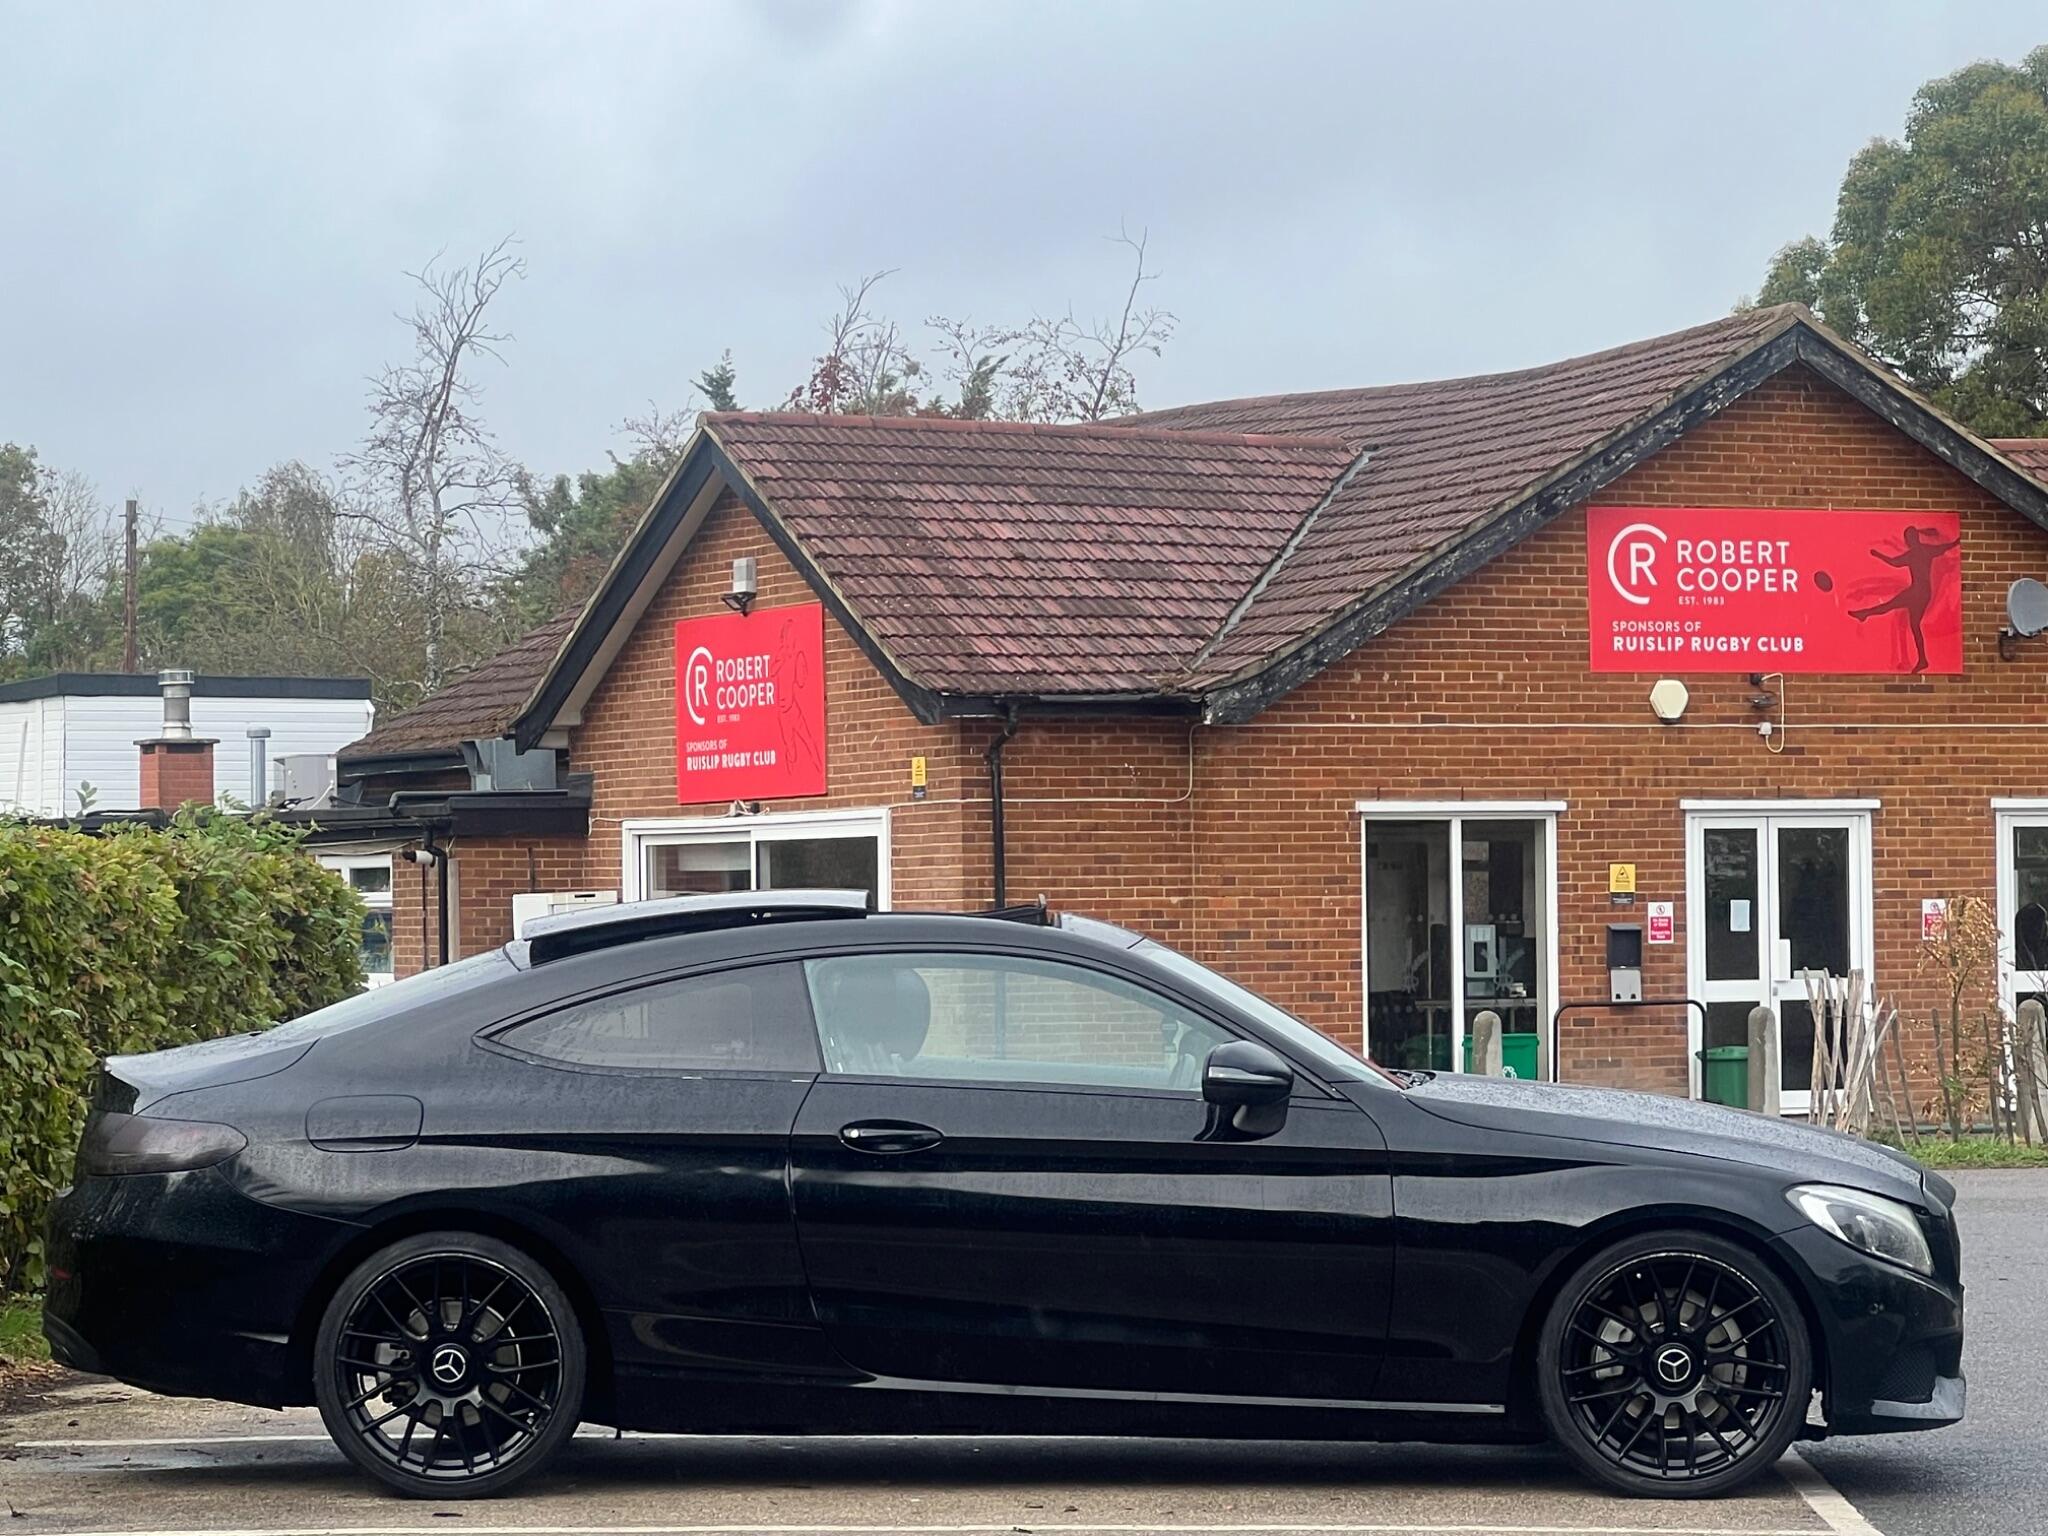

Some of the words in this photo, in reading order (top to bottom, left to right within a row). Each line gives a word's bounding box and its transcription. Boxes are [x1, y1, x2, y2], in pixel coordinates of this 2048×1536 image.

[1676, 540, 1790, 565] ROBERT
[1676, 568, 1798, 592] COOPER
[1678, 596, 1699, 606] EST.
[1612, 621, 1680, 633] SPONSORS
[1684, 621, 1702, 633] OF
[1613, 636, 1684, 652] RUISLIP
[1691, 636, 1751, 652] RUGBY
[1757, 637, 1804, 653] CLUB
[716, 654, 770, 683] ROBERT
[716, 682, 775, 710] COOPER
[686, 740, 718, 752] SPONSORS
[718, 739, 728, 750] OF
[686, 754, 720, 771] RUISLIP
[721, 752, 751, 769] RUGBY
[753, 749, 776, 766] CLUB
